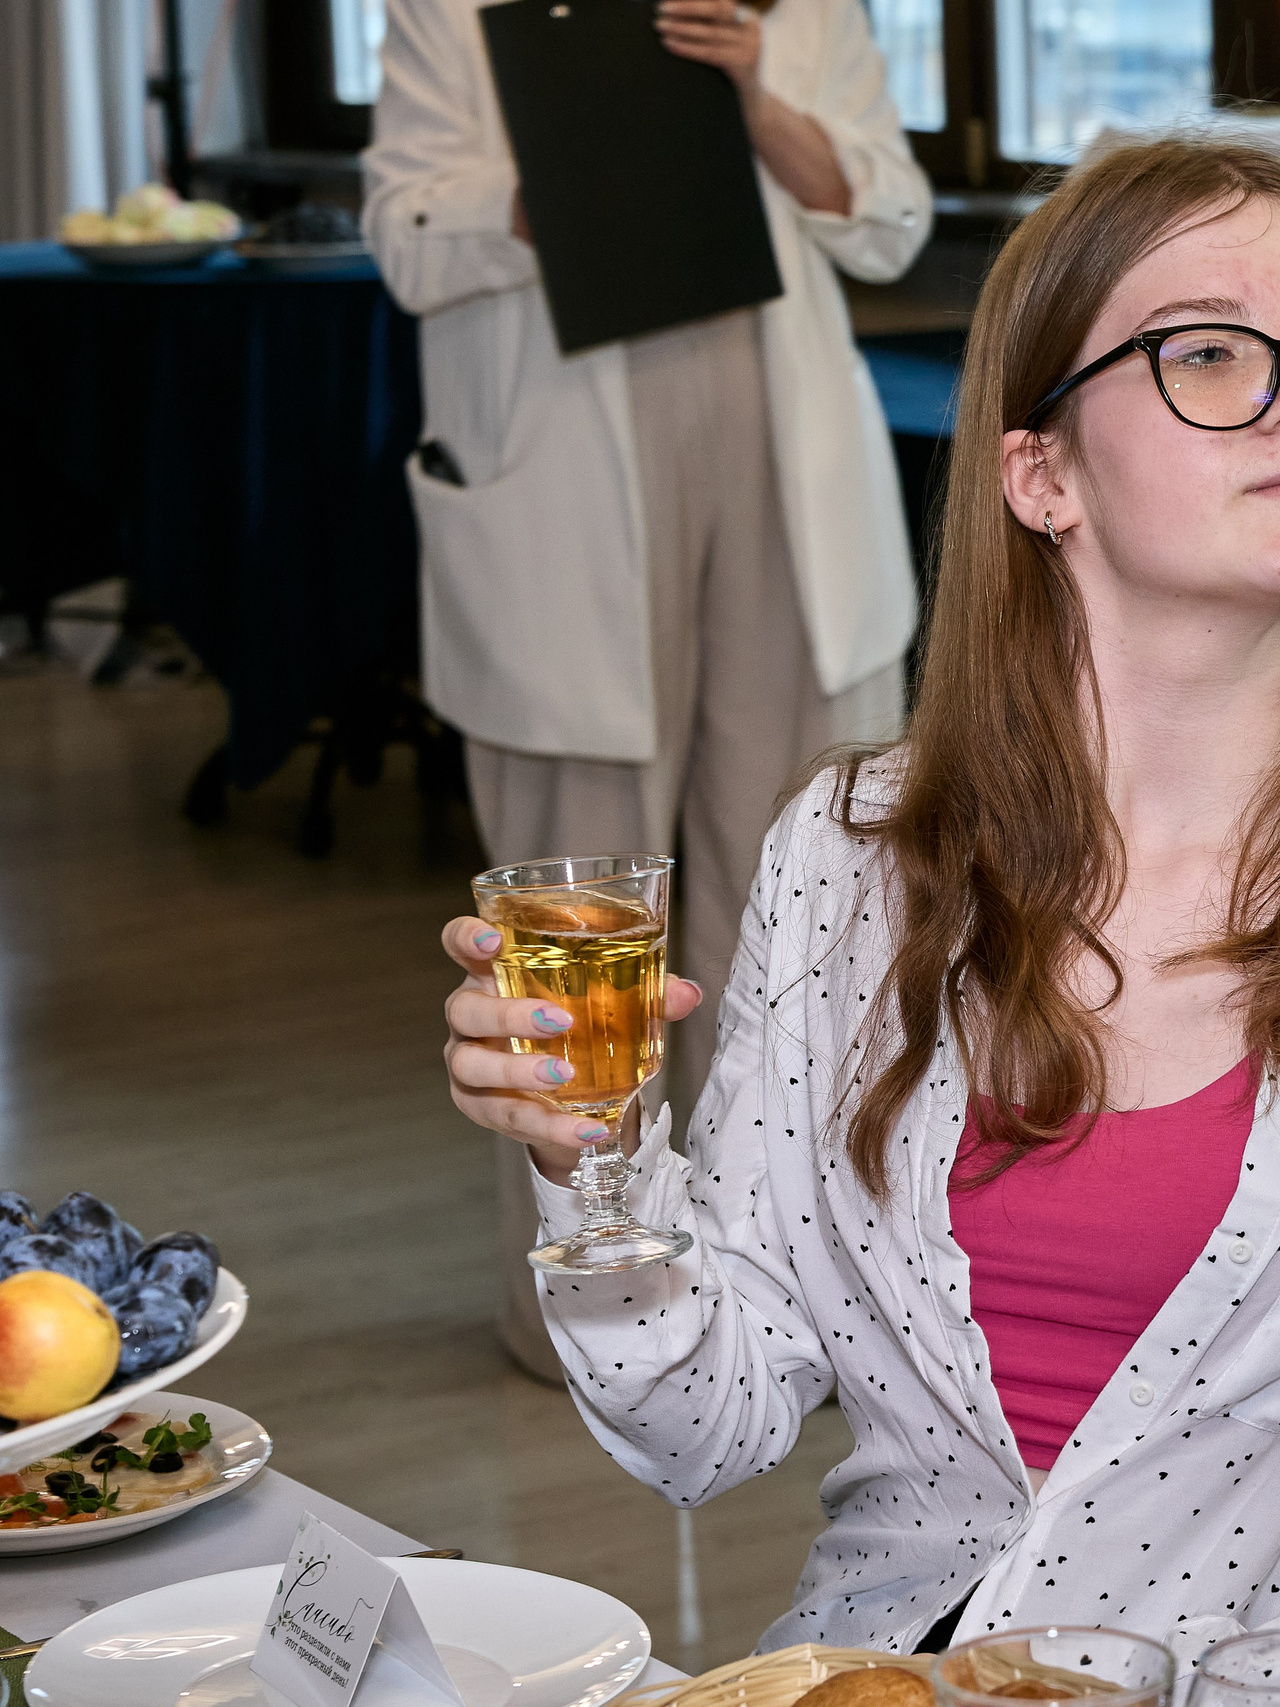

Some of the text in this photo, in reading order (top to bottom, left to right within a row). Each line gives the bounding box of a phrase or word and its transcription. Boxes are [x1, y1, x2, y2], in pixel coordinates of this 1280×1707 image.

[283, 1561, 374, 1643] Спасибо
[284, 1636, 350, 1689] этот прекрасный день!
[290, 1621, 352, 1673] что разделили с нами
